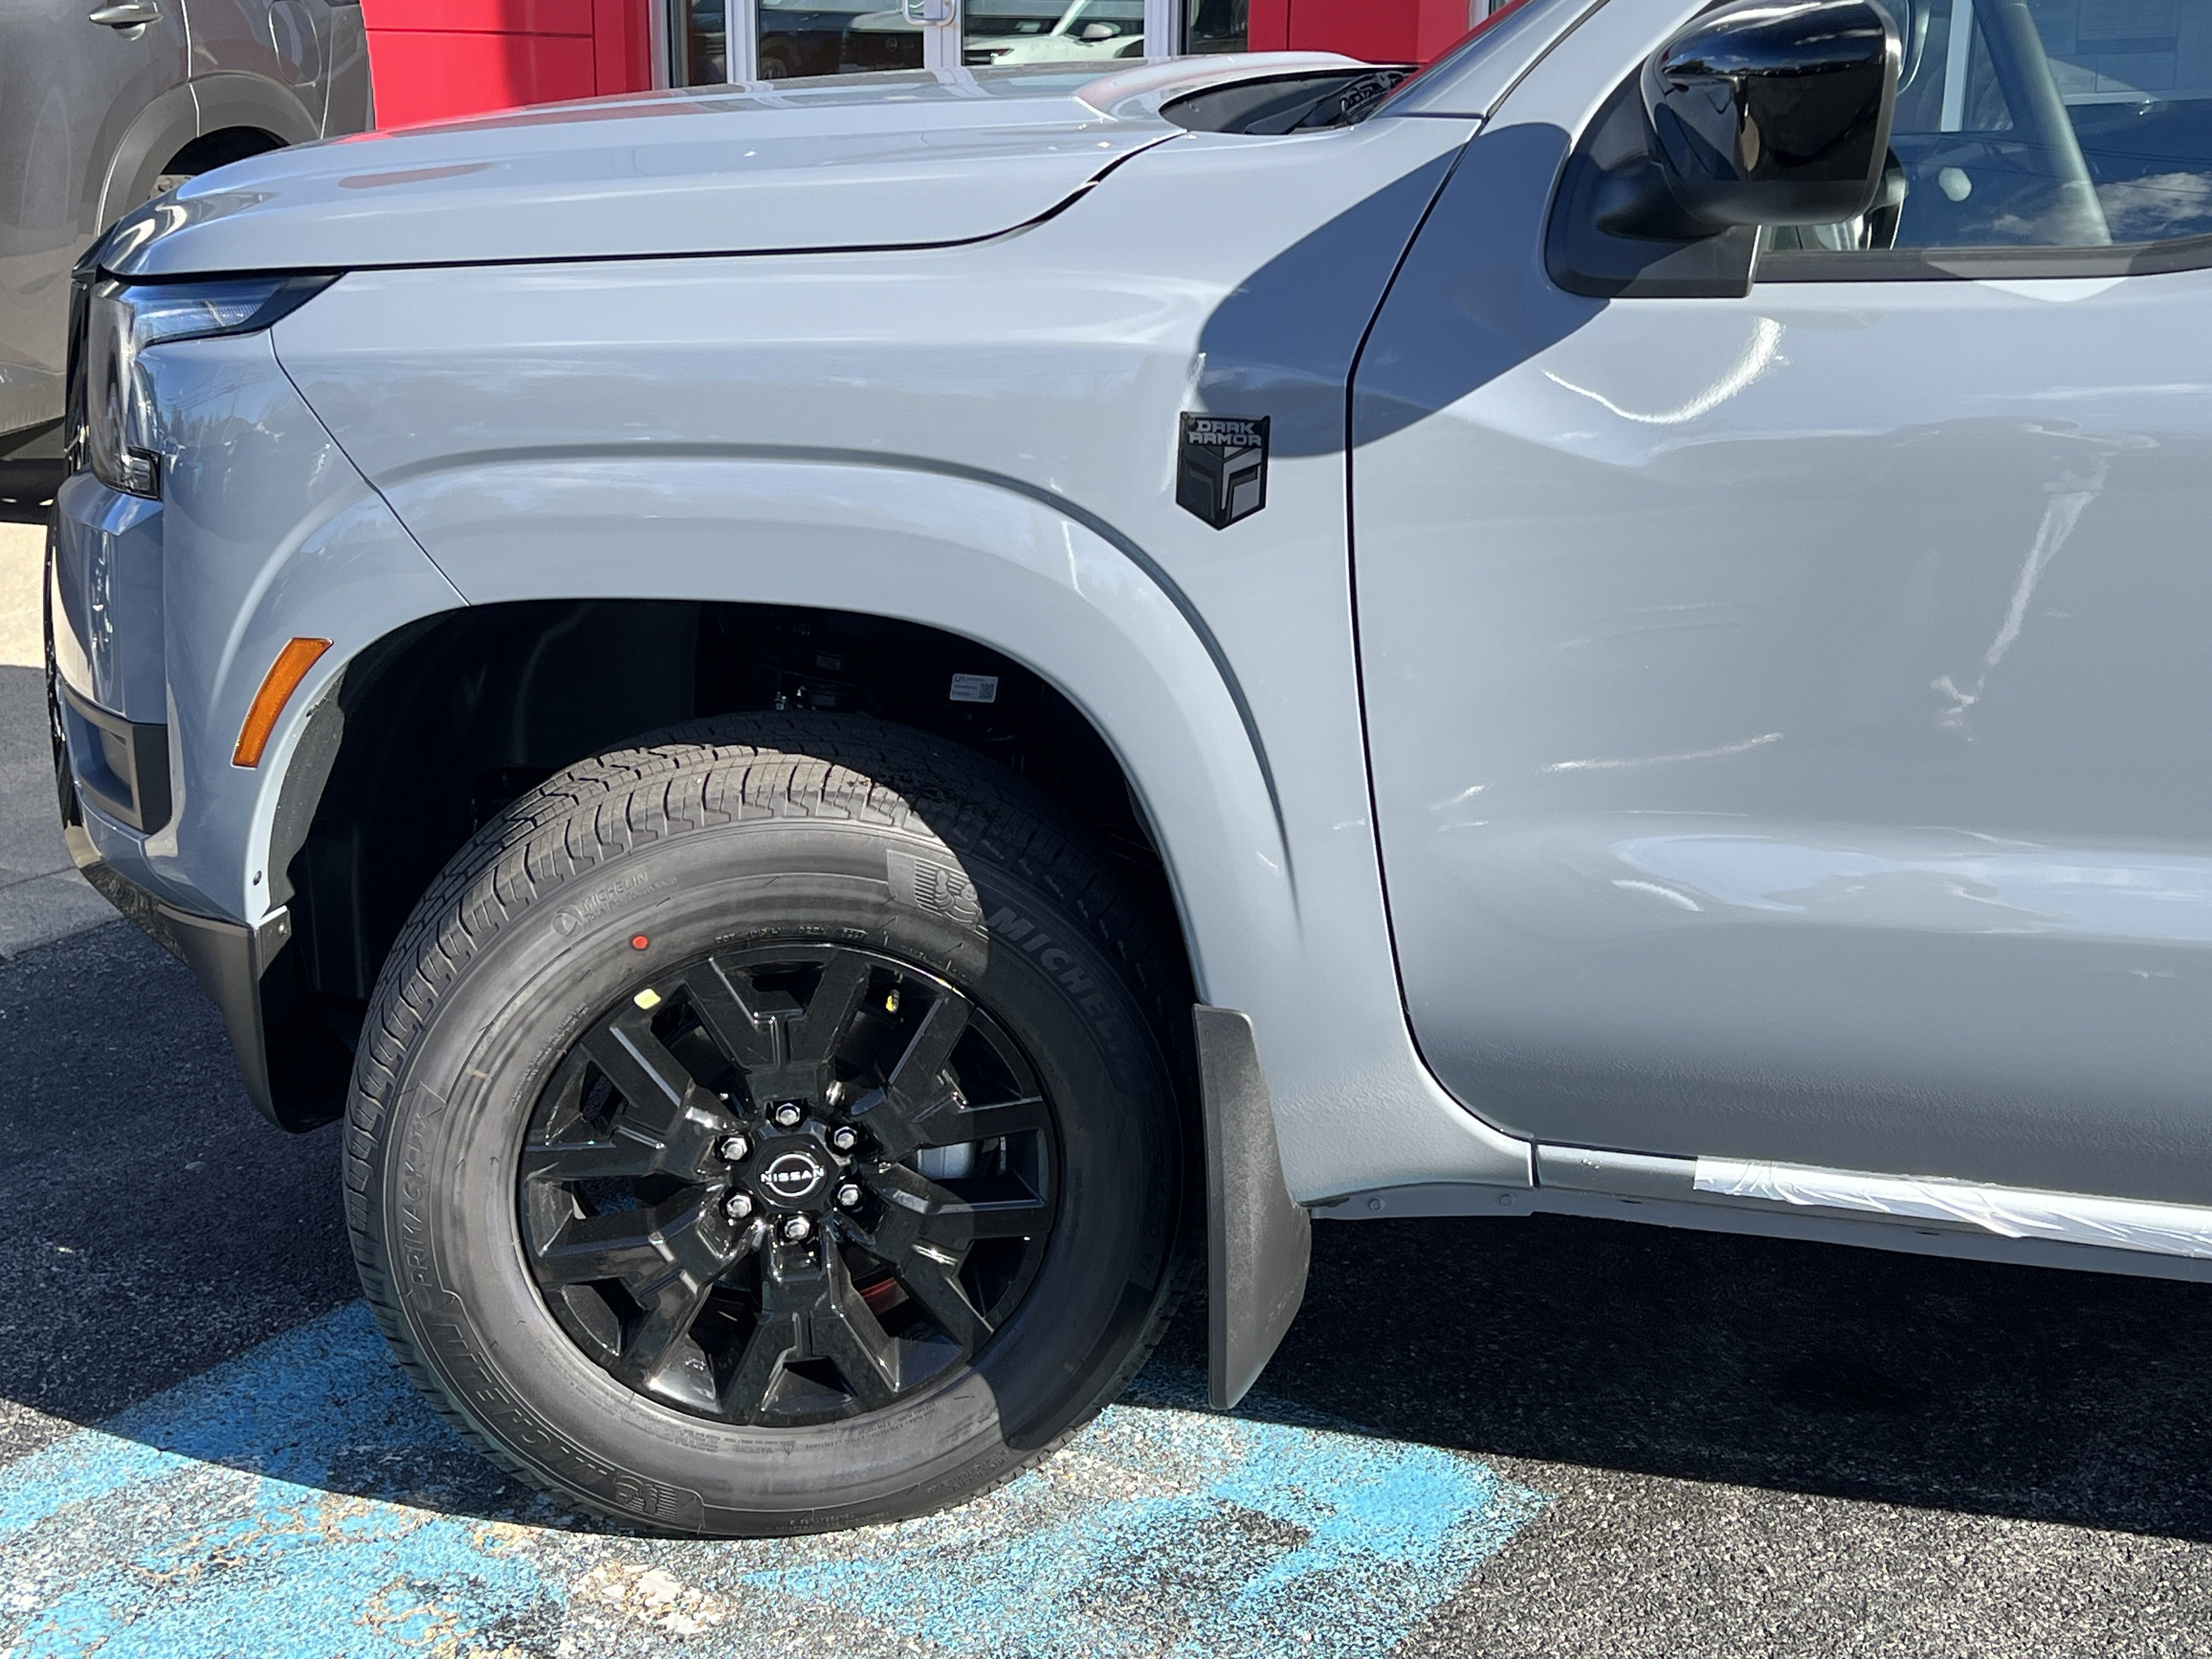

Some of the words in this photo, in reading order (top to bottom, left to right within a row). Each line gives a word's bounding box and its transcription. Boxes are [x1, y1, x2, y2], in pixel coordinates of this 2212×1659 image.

[1196, 420, 1255, 434] DARK
[1188, 431, 1261, 446] ARMOR
[582, 872, 649, 911] MICHELIN
[760, 1167, 825, 1183] NISSAN
[401, 1161, 432, 1288] PRIMACY
